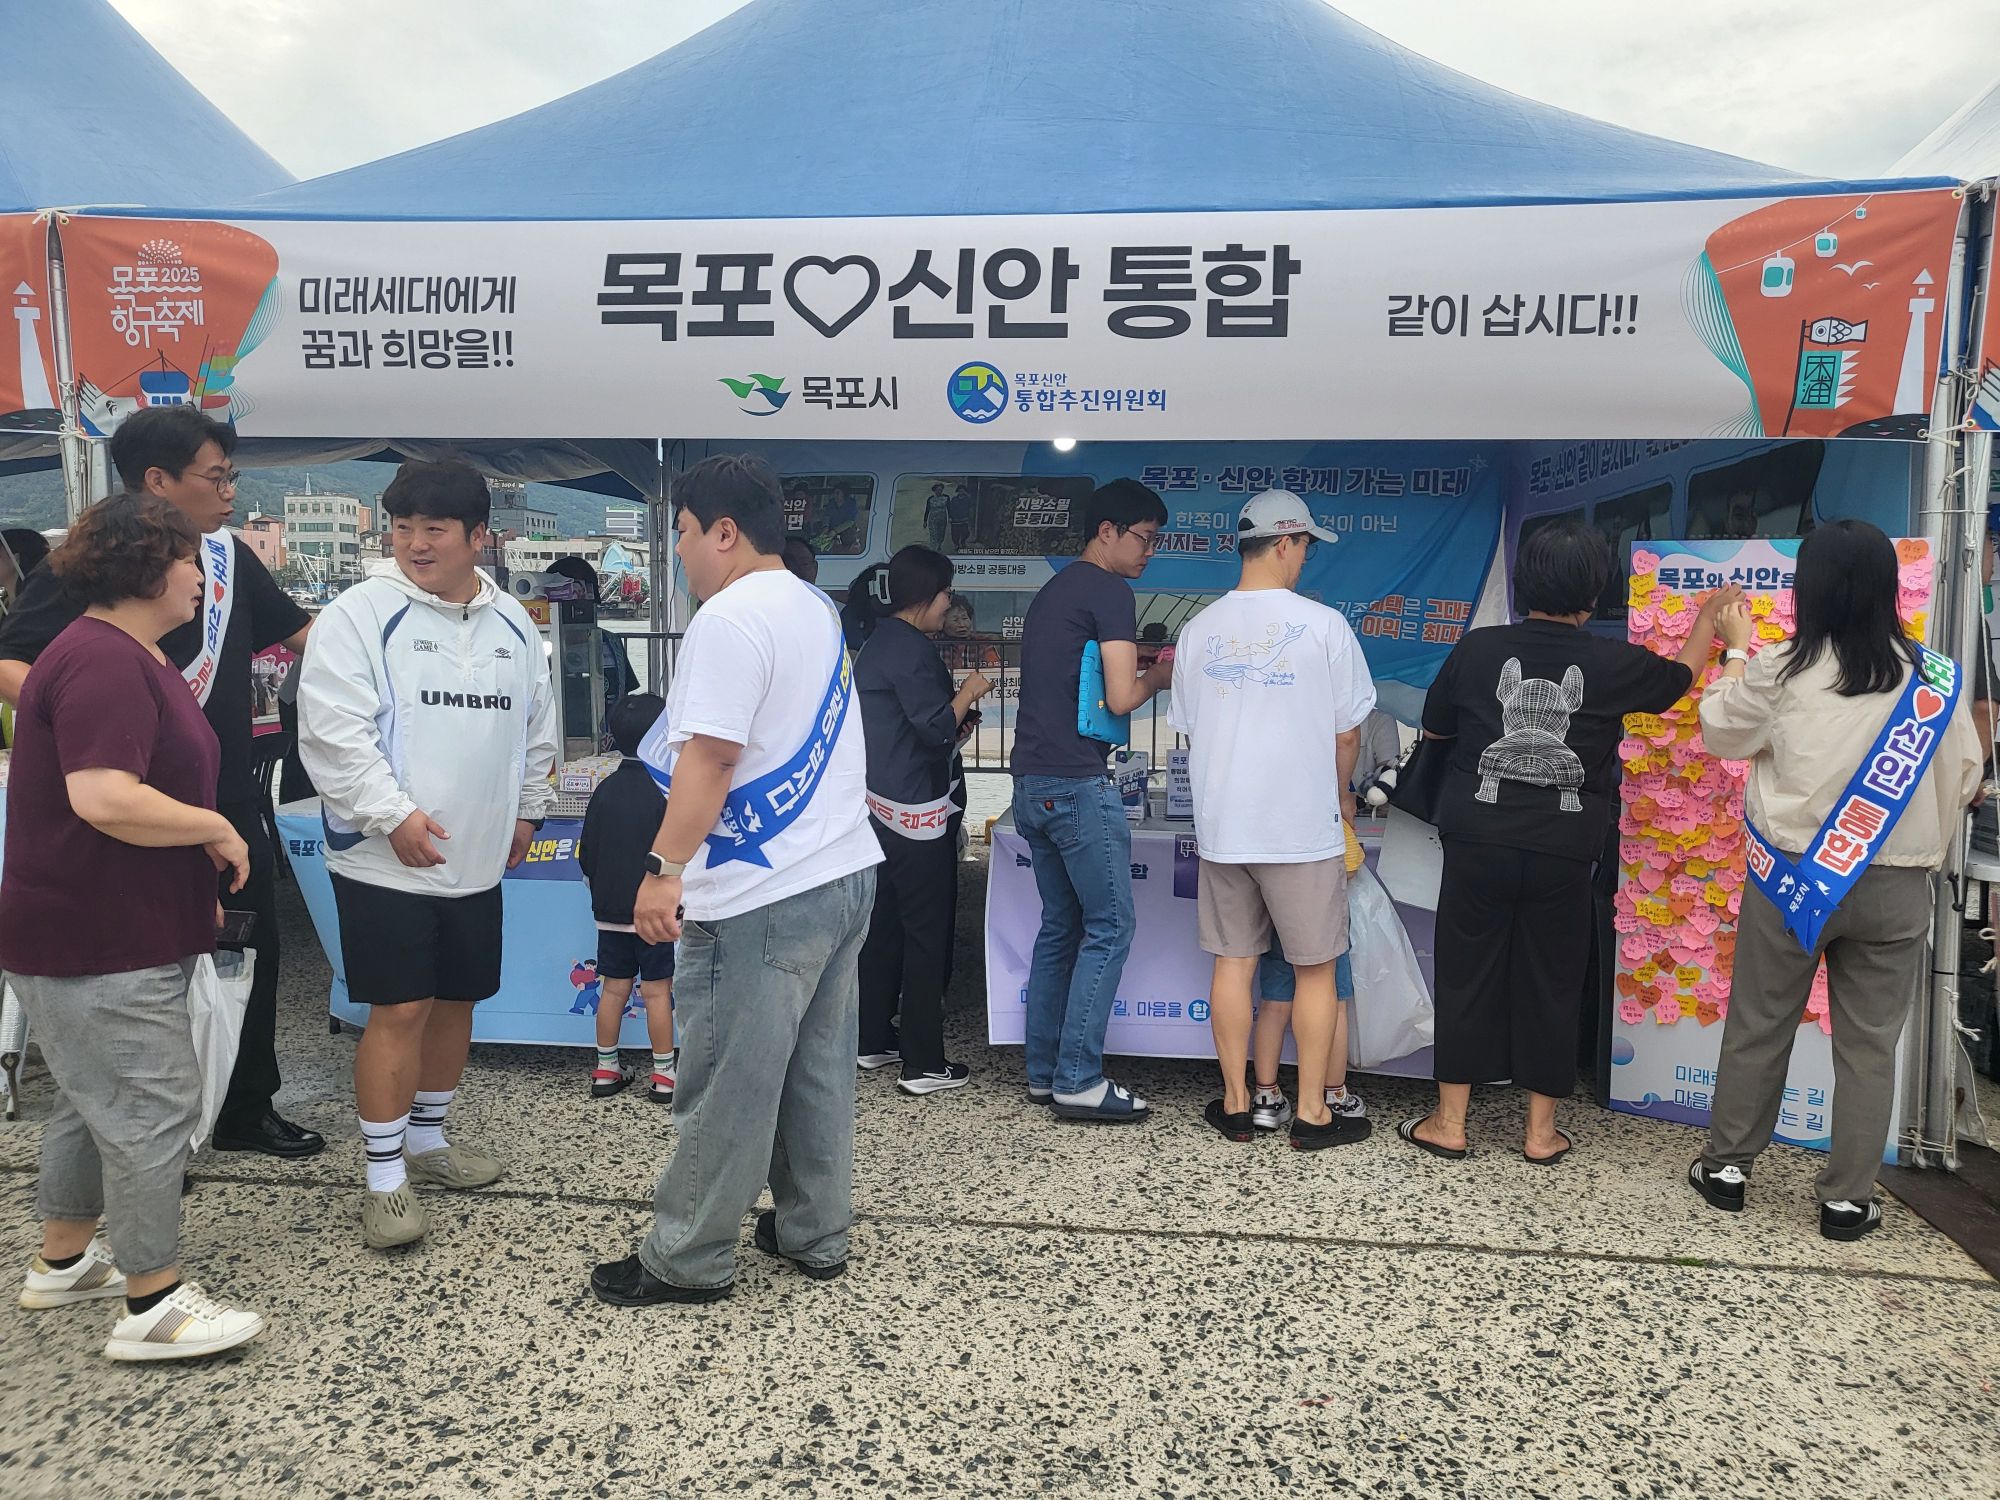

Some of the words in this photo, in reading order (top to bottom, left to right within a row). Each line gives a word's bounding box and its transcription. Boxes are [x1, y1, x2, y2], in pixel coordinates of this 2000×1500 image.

[160, 266, 200, 283] 2025
[299, 275, 516, 316] 미래세대에게
[596, 252, 776, 342] 목포
[889, 247, 1079, 339] 신안
[1104, 244, 1301, 339] 통합
[110, 295, 204, 349] 항구축제
[1387, 294, 1469, 337] 같이
[1482, 294, 1639, 337] 삽시다!!
[302, 330, 373, 371] 꿈과
[381, 328, 514, 371] 희망을!!
[1014, 373, 1067, 387] 목포신안
[802, 376, 899, 410] 목포시
[1014, 389, 1166, 412] 통합추진위원회
[1141, 465, 1198, 491] 목포
[1217, 465, 1276, 493] 신안
[1281, 465, 1340, 495] 함께
[1344, 466, 1404, 496] 가는
[1410, 467, 1471, 497] 미래
[1016, 498, 1071, 511] 지방소멸
[784, 514, 804, 531] 면
[1014, 512, 1069, 526] 공동대응
[1176, 512, 1230, 530] 한쪽이
[1361, 515, 1397, 533] 아닌
[953, 565, 985, 575] 방소멸
[988, 565, 1027, 575] 공동대응
[1658, 568, 1723, 589] 목포와
[1362, 615, 1418, 640] 이익은
[421, 690, 511, 711] UMBRO
[1868, 725, 1930, 796] 신안
[765, 739, 825, 817] 삽시다
[900, 804, 948, 830] 삽시다
[289, 839, 316, 857] 목포
[1818, 798, 1886, 874] 통합
[526, 838, 573, 863] 신안은
[1137, 1000, 1183, 1018] 마음을
[1807, 1088, 1825, 1107] 길
[1674, 1089, 1716, 1112] 마음
[1806, 1112, 1824, 1132] 길
